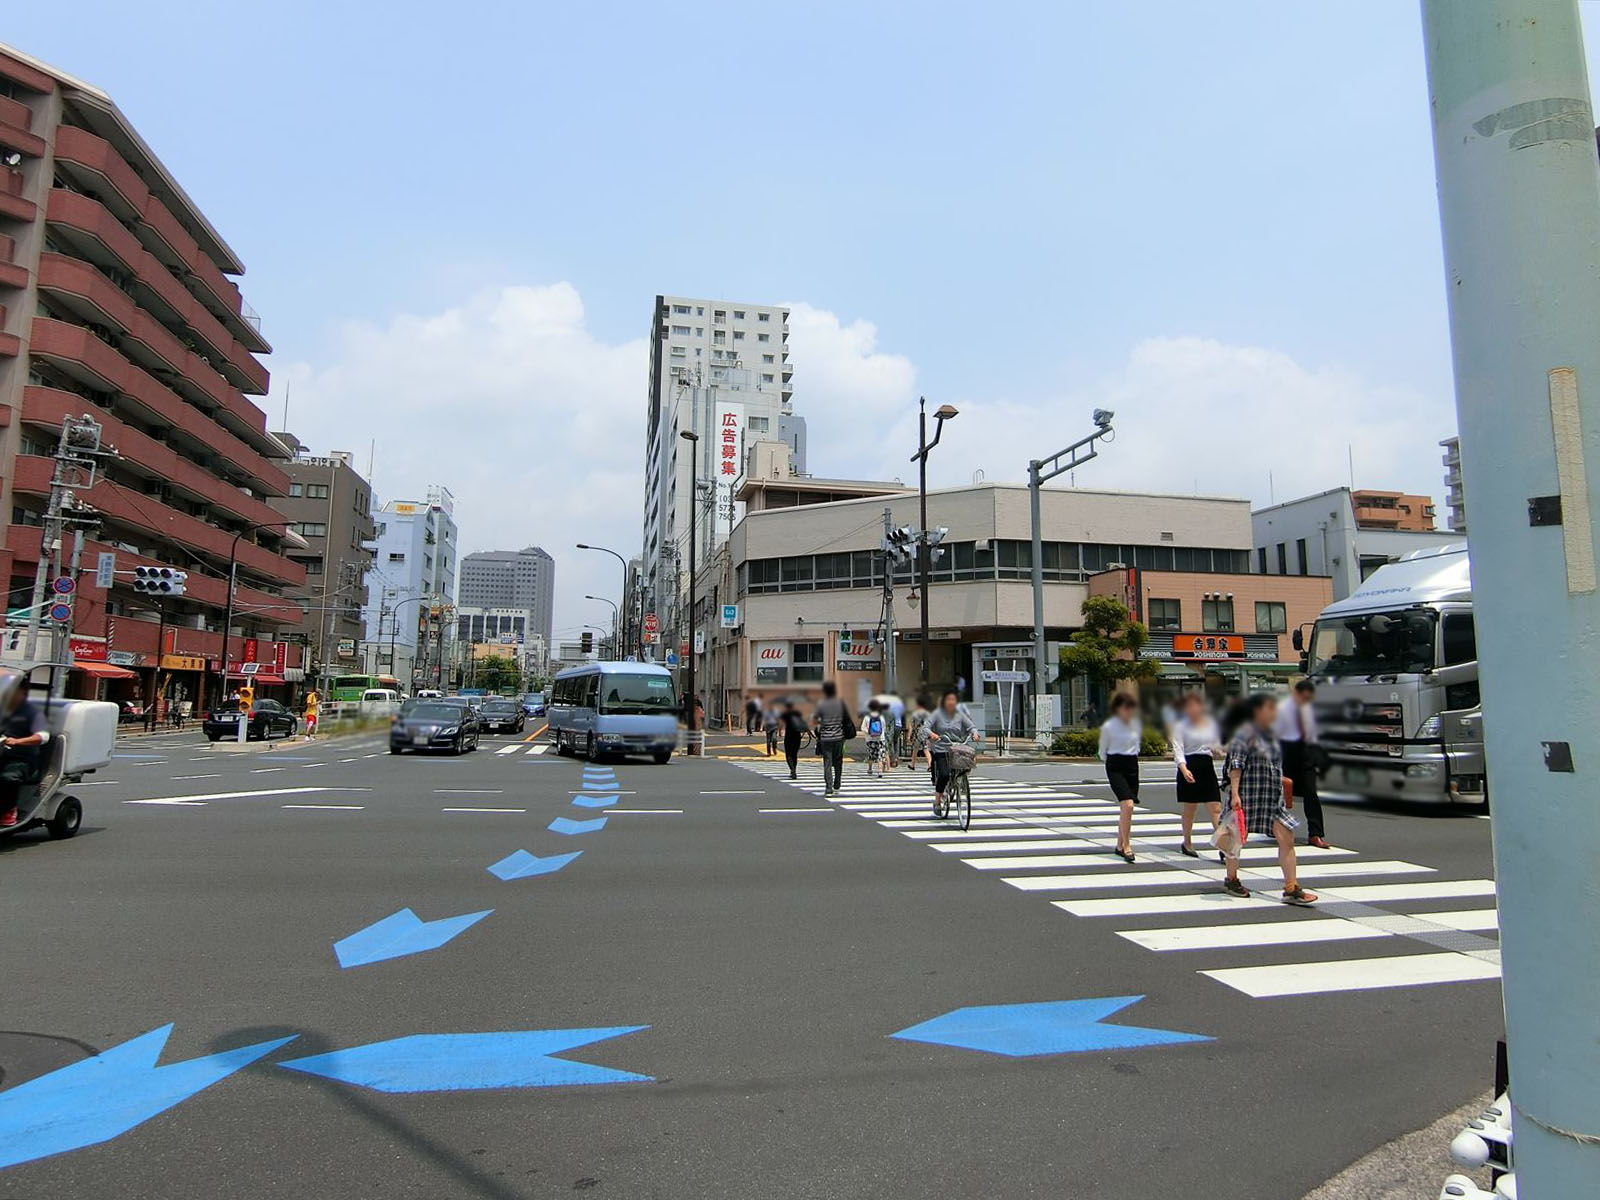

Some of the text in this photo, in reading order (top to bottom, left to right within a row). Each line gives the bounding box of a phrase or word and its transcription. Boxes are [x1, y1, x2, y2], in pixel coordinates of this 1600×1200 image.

[721, 412, 737, 476] 広告募集
[760, 647, 785, 660] au
